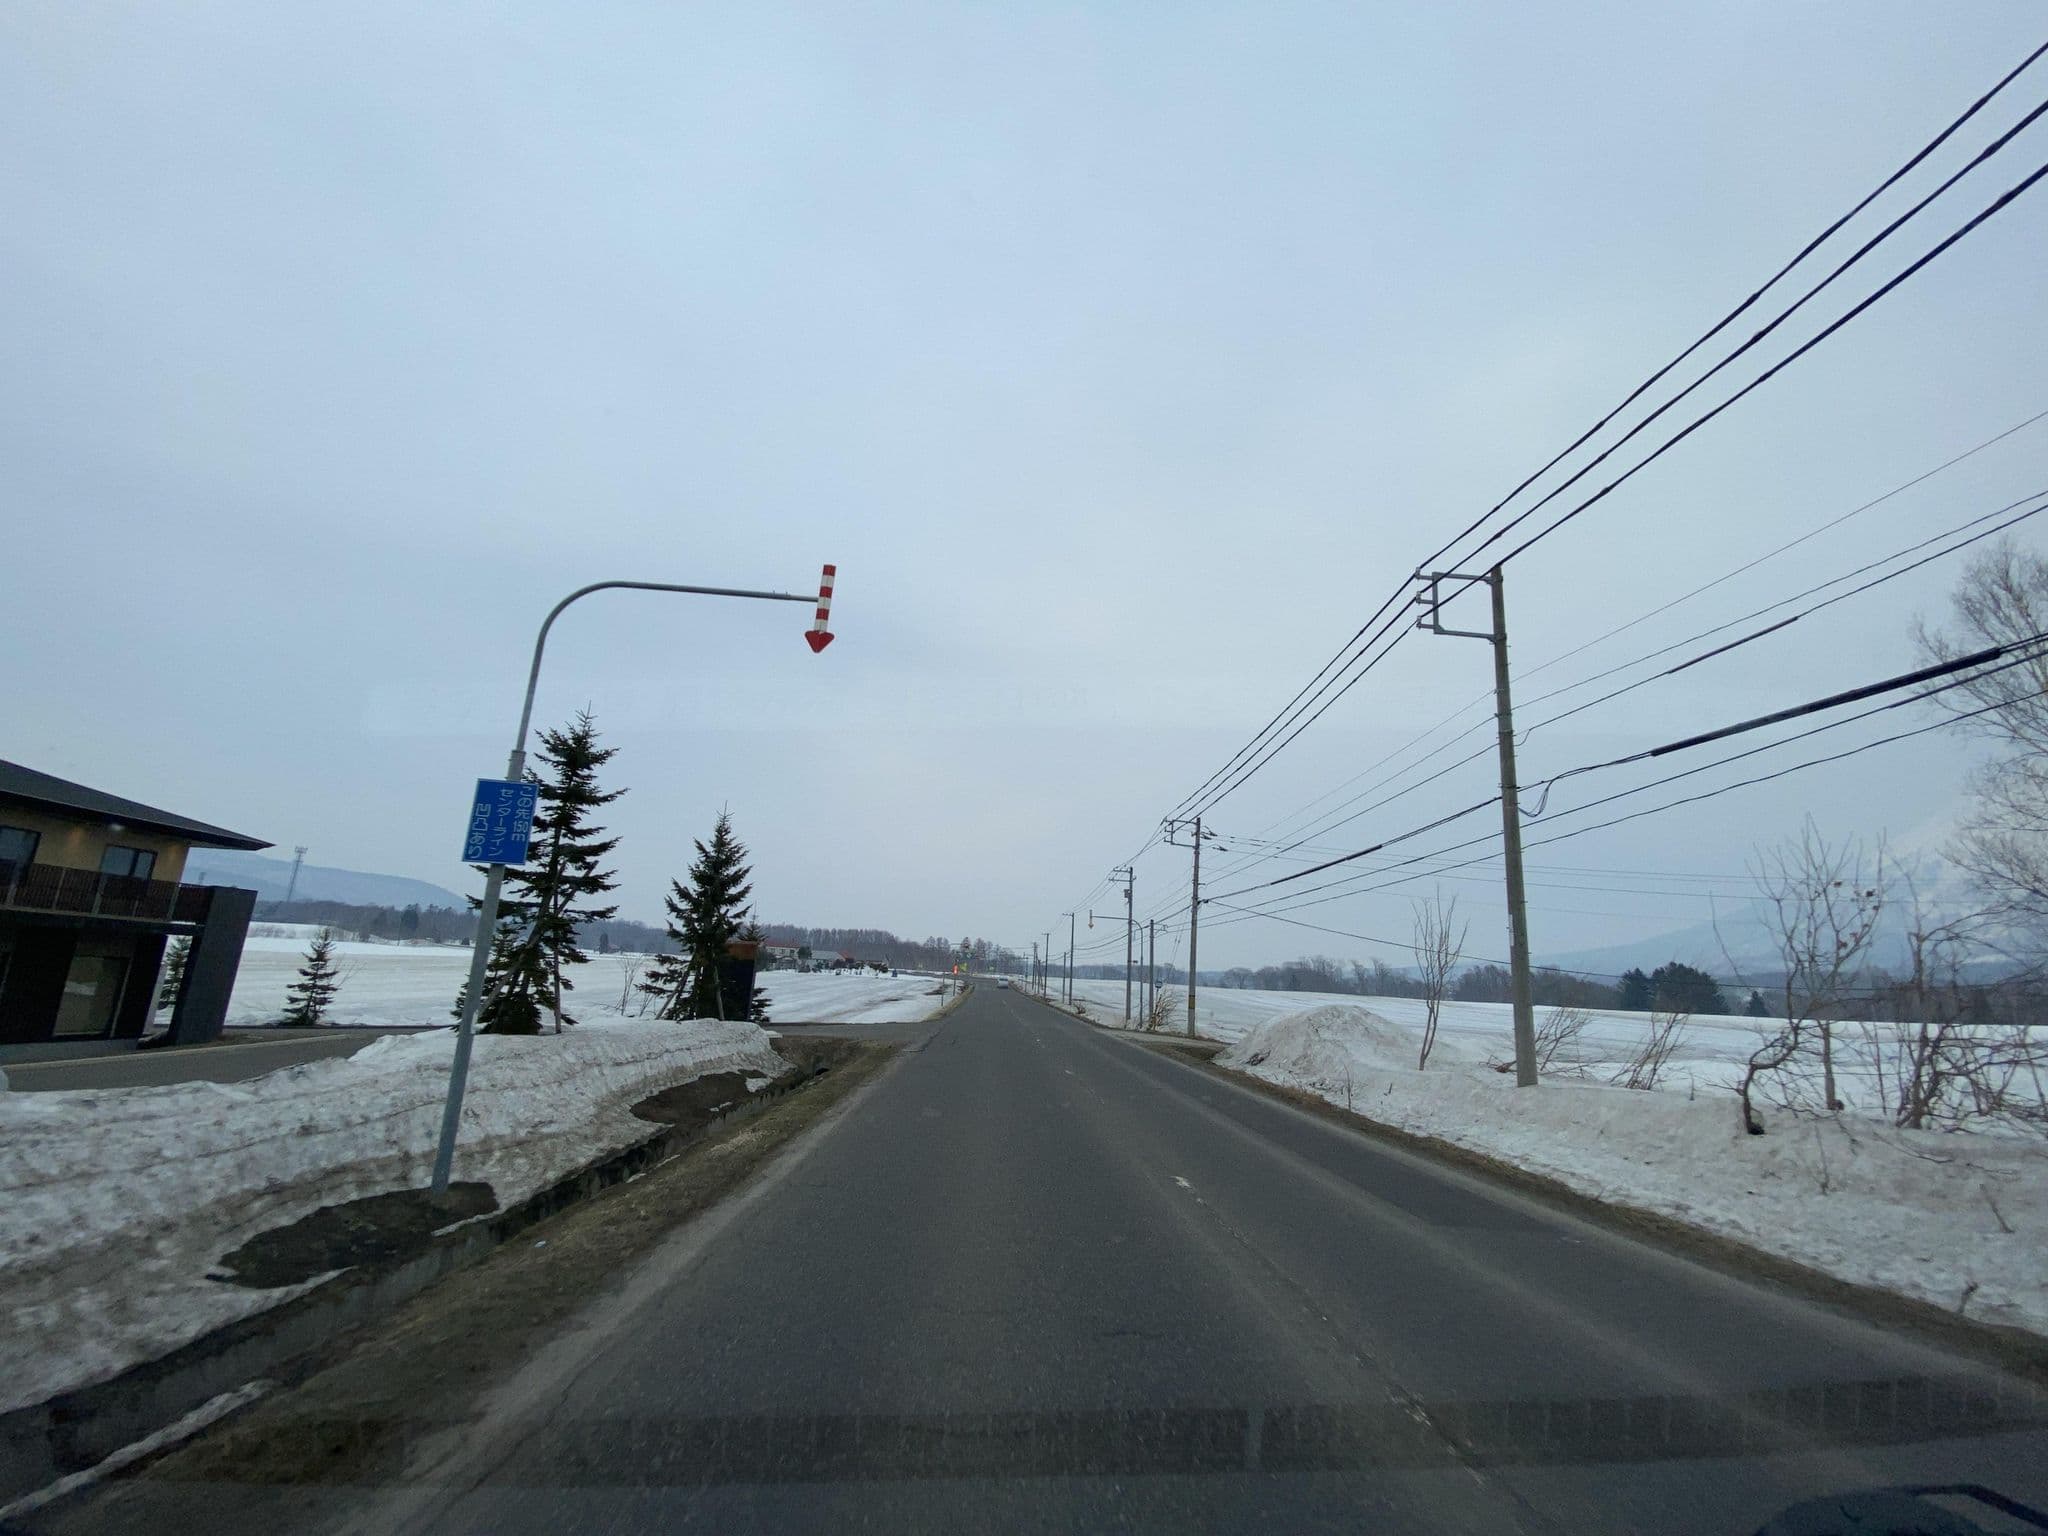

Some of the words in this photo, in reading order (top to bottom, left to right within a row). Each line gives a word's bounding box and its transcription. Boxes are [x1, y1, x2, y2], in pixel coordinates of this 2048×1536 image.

[468, 803, 491, 859] 凹凸あり
[488, 787, 514, 856] センターライン
